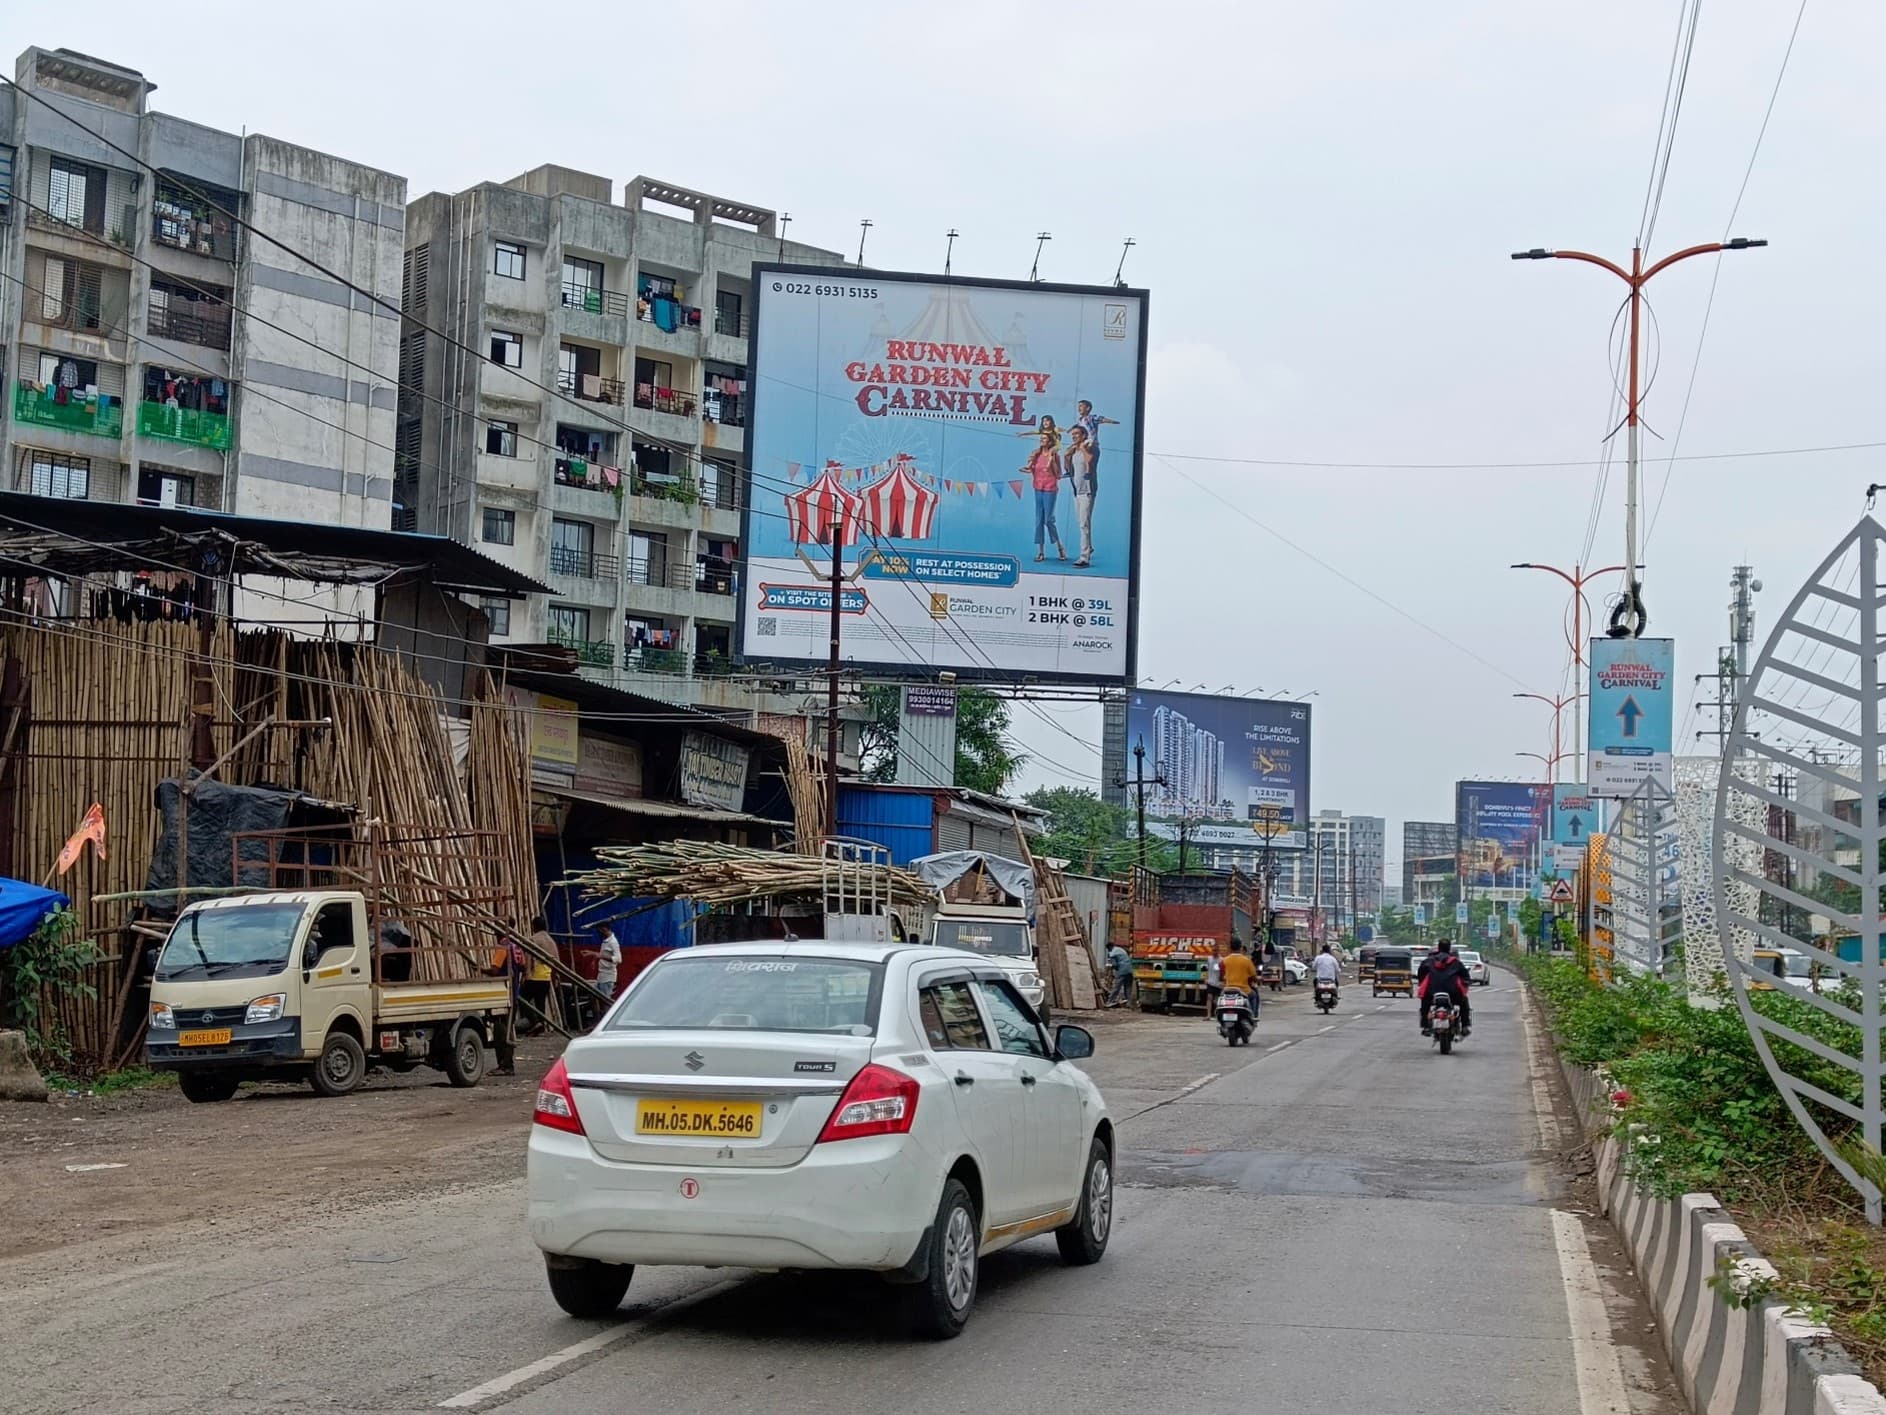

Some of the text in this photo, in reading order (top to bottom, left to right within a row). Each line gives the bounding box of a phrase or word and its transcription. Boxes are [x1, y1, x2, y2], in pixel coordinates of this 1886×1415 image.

[786, 283, 878, 299] 022 6931 5135
[886, 340, 1011, 368] RUNWAL
[844, 361, 1051, 394] GARDEN CITY
[854, 384, 1037, 426] CARNIVAL
[882, 565, 909, 574] NOW
[916, 558, 1012, 572] REST AT POSSESSION
[916, 566, 930, 575] ON
[931, 567, 966, 577] SELECT
[768, 595, 785, 604] ON
[787, 596, 818, 606] SPOT
[1029, 596, 1112, 611] 1 BHK @ 39L
[950, 603, 1017, 616] GARDEN CITY
[1028, 612, 1114, 627] 2 BHK @ 58L
[1072, 640, 1113, 649] ANAROCK
[1610, 663, 1653, 672] RUNWAL
[1597, 671, 1666, 680] GARDEN CITY
[1600, 678, 1662, 690] CARNIVAL
[908, 687, 956, 697] MEDIAWISE
[1270, 726, 1292, 735] ABOVE
[1245, 732, 1300, 745] THE LIMITATIONS
[642, 1112, 754, 1133] MH.05.DK.5646
[684, 1182, 696, 1196] T
